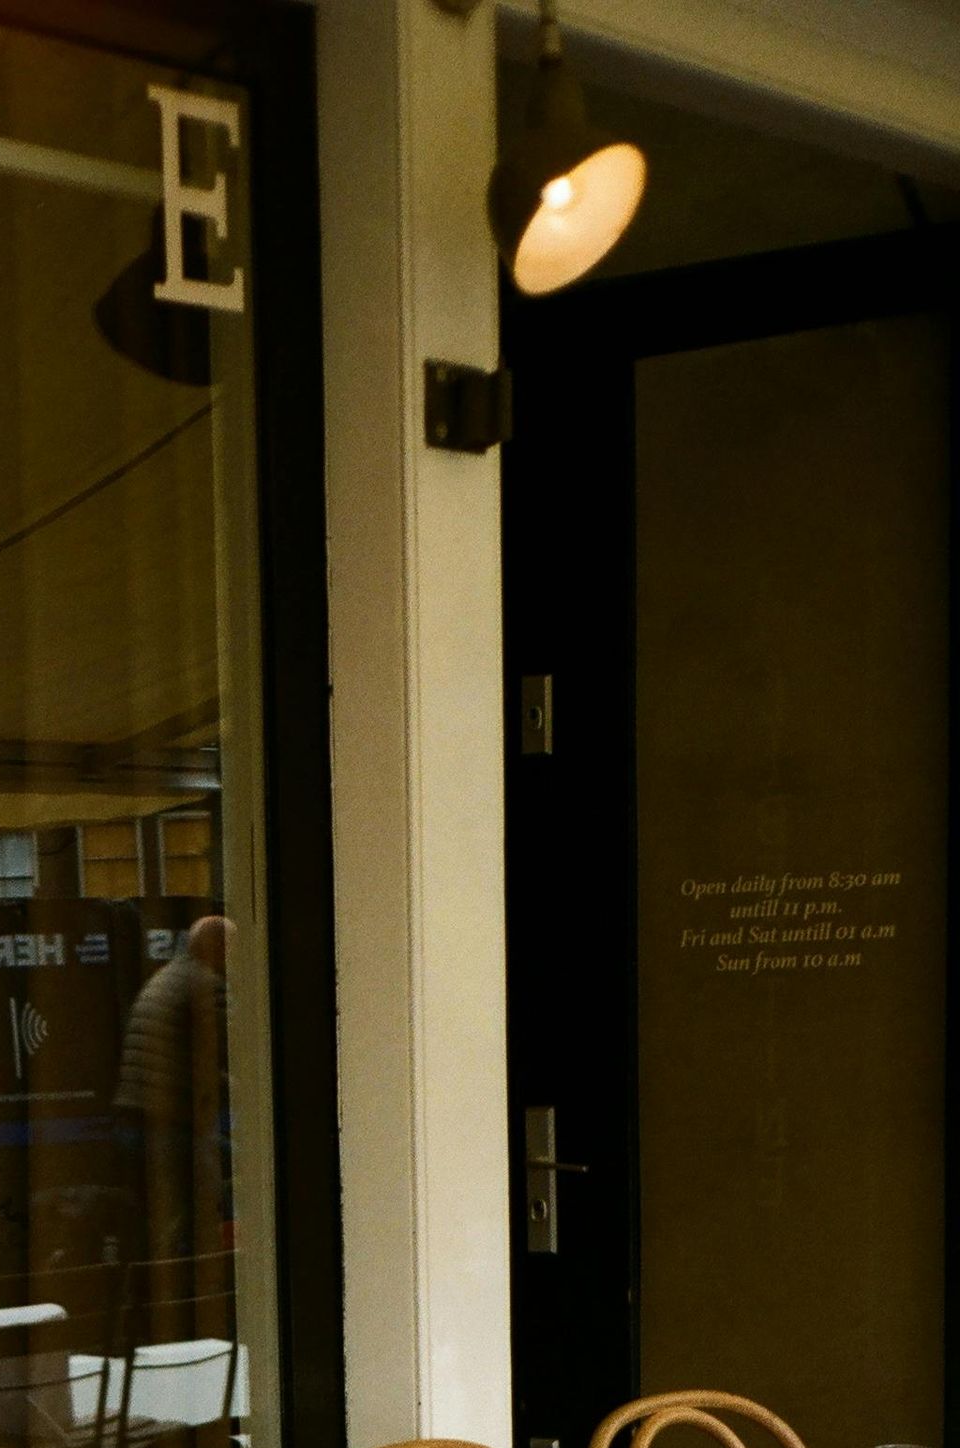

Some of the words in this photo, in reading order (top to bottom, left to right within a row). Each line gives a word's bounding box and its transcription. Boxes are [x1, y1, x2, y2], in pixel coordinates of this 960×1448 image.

[147, 83, 244, 312] E
[680, 878, 726, 899] Open
[731, 875, 776, 897] daily
[778, 873, 823, 896] from
[871, 871, 902, 886] am
[730, 900, 777, 918] untill
[804, 899, 842, 919] p.m.
[680, 928, 705, 947] Fri
[709, 926, 743, 945] and
[747, 925, 776, 944] Sat
[716, 953, 749, 972] Sun
[752, 951, 797, 975] from
